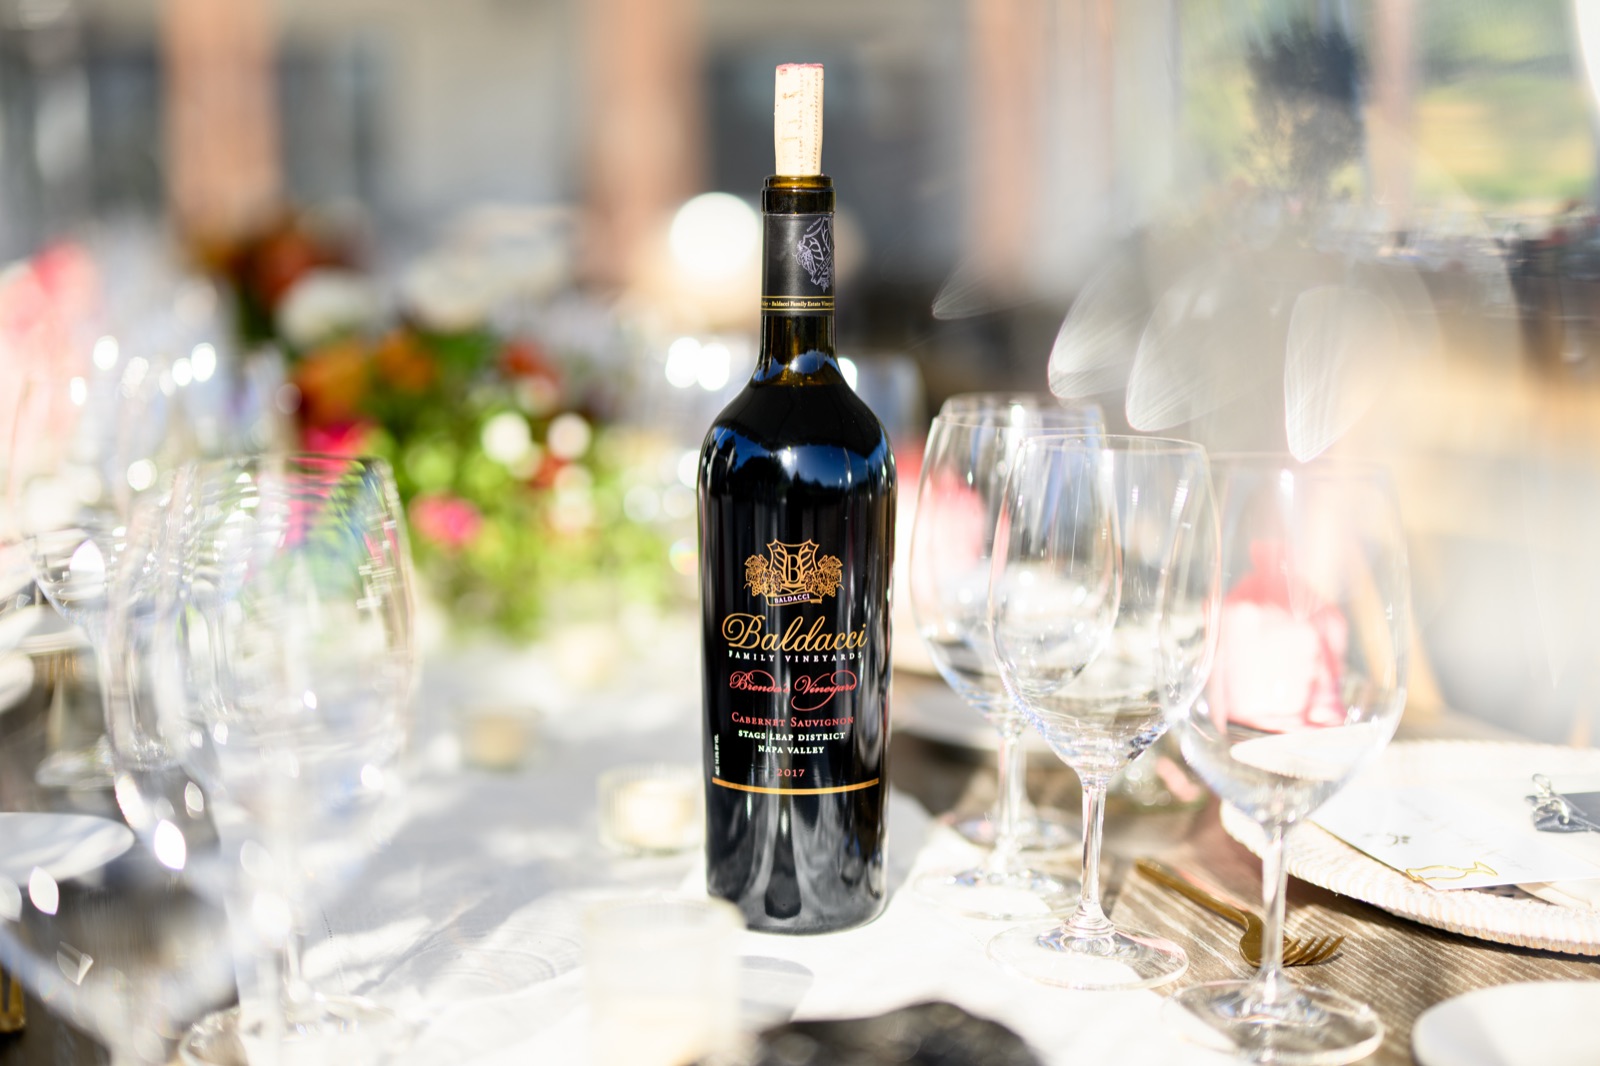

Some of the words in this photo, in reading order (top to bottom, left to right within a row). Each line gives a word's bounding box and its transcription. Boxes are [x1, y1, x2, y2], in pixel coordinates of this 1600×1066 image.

[787, 554, 800, 583] B
[774, 593, 810, 604] BALDACCI
[722, 612, 868, 652] Baldacci
[728, 650, 775, 662] FAMILY
[785, 651, 863, 663] VINEYARDS
[729, 669, 790, 693] Brenda's
[791, 669, 857, 711] Vineyard
[731, 711, 786, 727] CABERNET
[790, 716, 854, 728] SAUVIGNON
[738, 729, 766, 740] STAGS
[769, 732, 794, 741] LEAP
[798, 731, 846, 741] DISTRICT
[758, 744, 783, 754] NAPA
[787, 746, 824, 754] VALLEY
[776, 768, 805, 777] 2017
